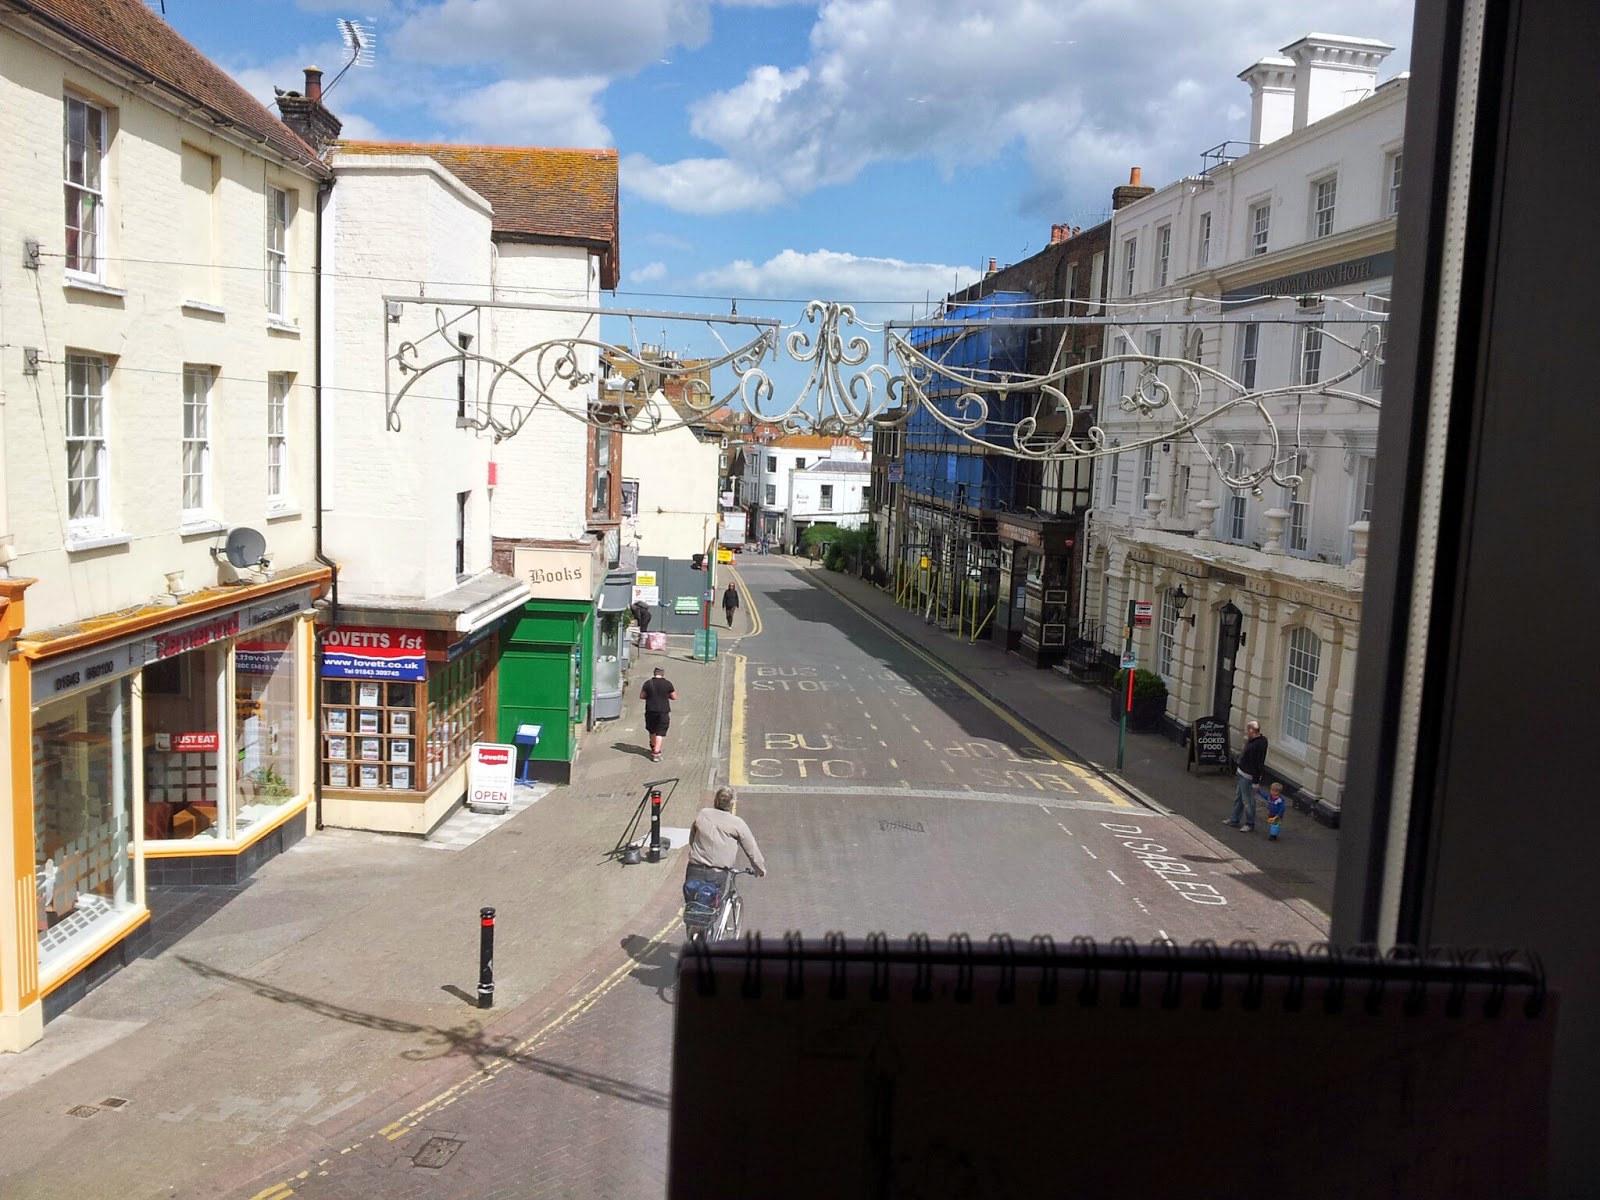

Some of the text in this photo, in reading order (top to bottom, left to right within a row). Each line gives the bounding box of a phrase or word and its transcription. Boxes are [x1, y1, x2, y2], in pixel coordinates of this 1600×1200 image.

[1275, 279, 1300, 295] ROYAL
[1303, 271, 1337, 290] ALBION
[1339, 261, 1372, 281] HOTEL
[529, 567, 582, 584] Books
[321, 631, 422, 649] LOVETTS 1st
[757, 667, 817, 677] BUS
[173, 735, 216, 743] JUST EAT
[480, 753, 508, 761] Lovetts
[475, 790, 507, 801] OPEN
[1100, 823, 1227, 905] DISABLED
